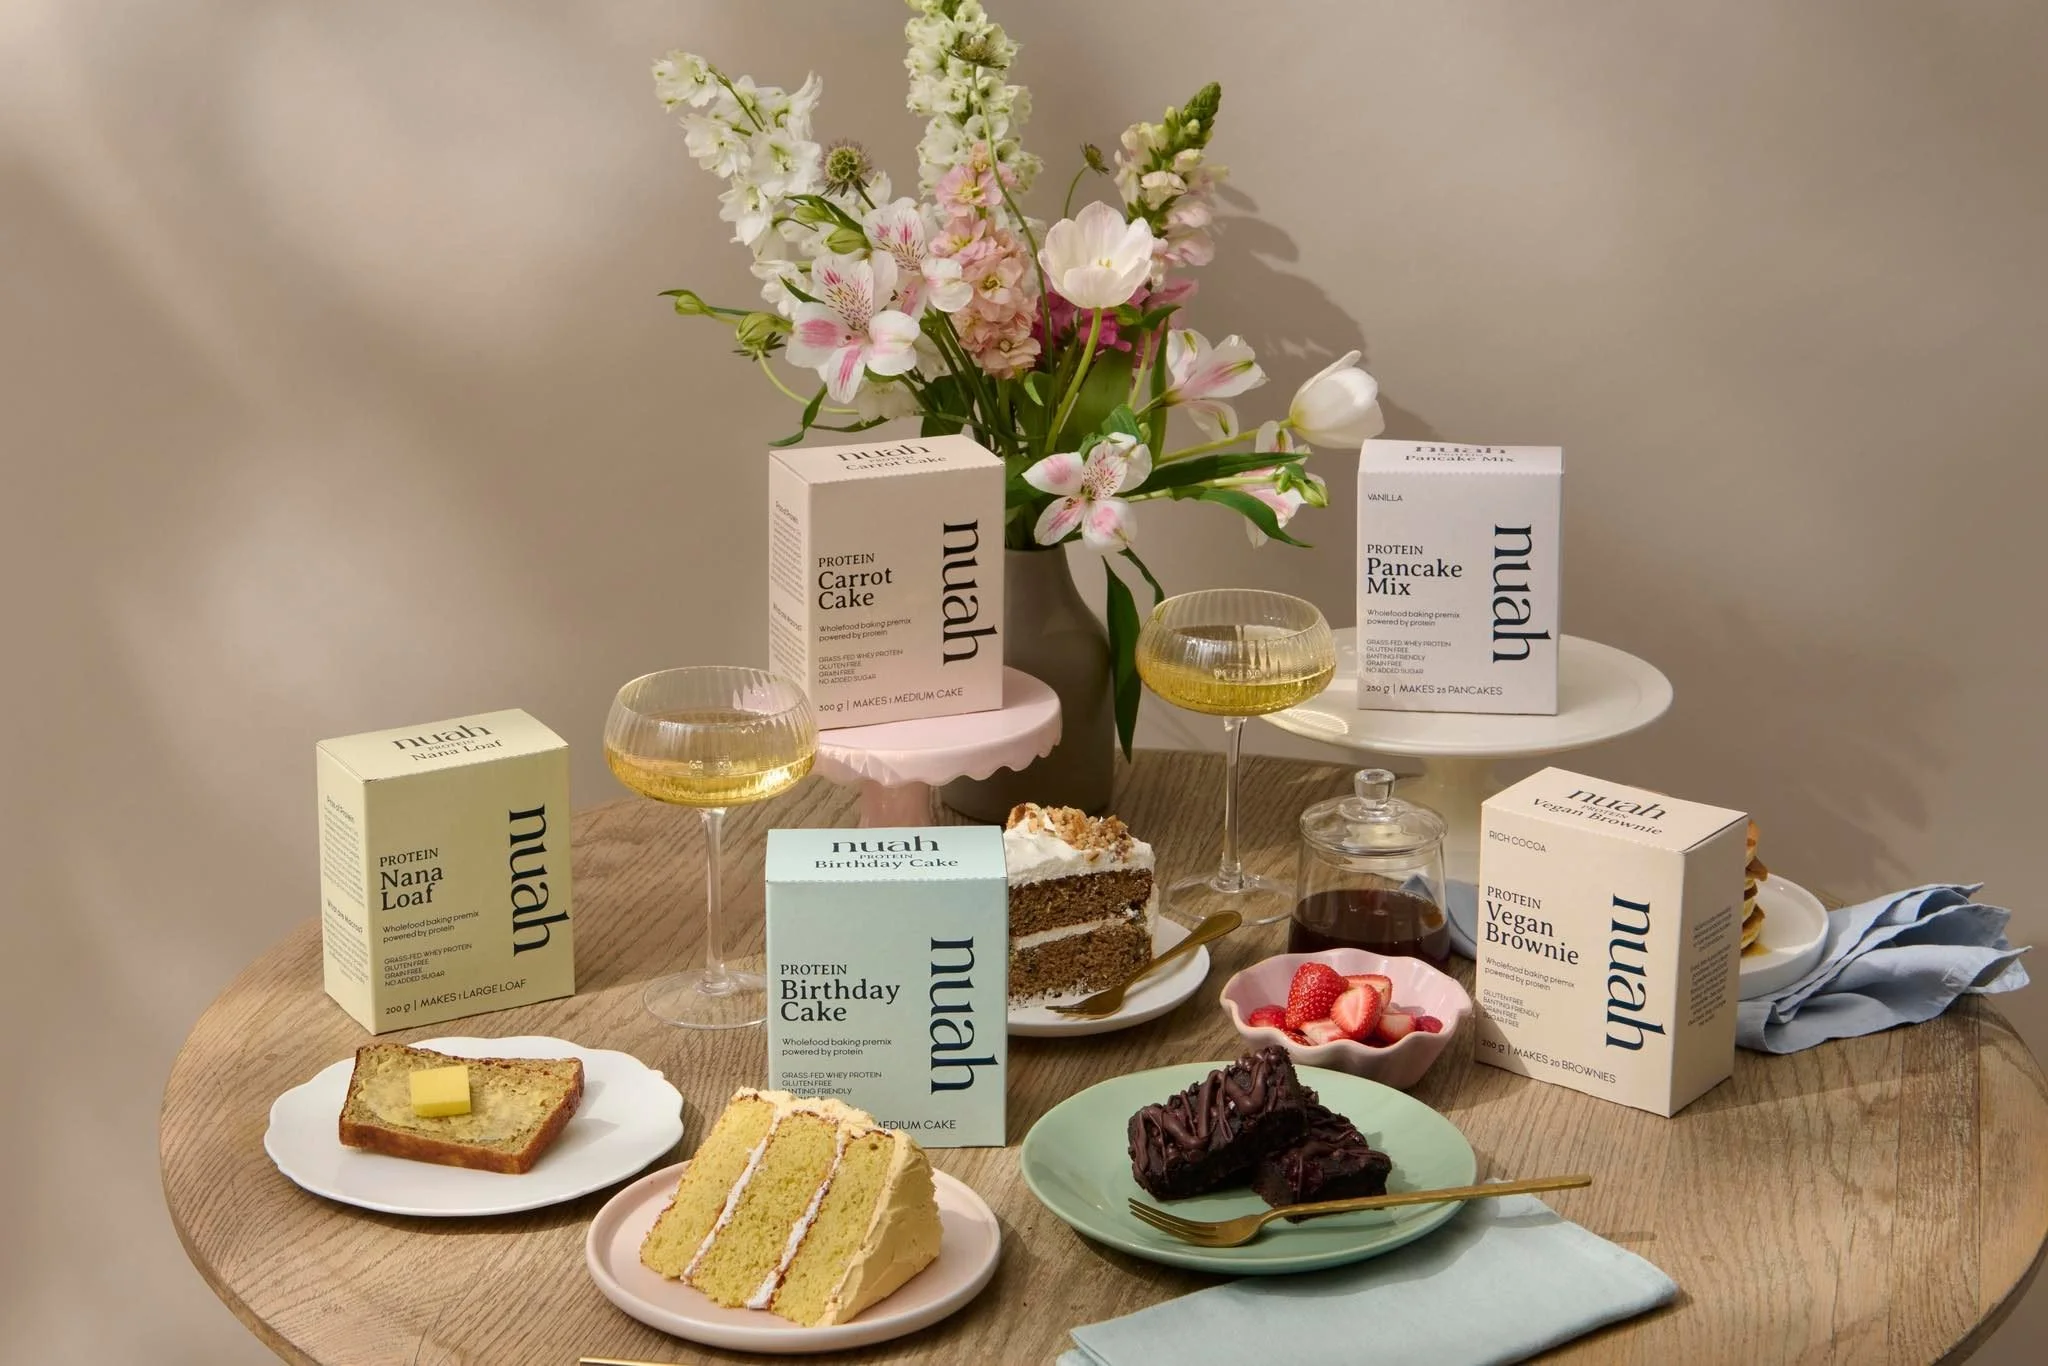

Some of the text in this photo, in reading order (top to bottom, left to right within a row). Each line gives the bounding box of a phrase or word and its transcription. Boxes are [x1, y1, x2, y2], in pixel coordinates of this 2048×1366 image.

[838, 445, 931, 460] nuah
[846, 461, 900, 470] Carrot
[1367, 544, 1423, 555] PROTEIN
[818, 552, 874, 568] PROTEIN
[1368, 558, 1462, 577] Pancake
[818, 568, 892, 590] Carrot
[1368, 577, 1411, 595] Mix
[818, 588, 874, 610] Cake
[942, 519, 998, 666] nuah
[1492, 523, 1551, 663] nuah
[1367, 618, 1398, 626] powered
[1400, 619, 1408, 627] by
[1409, 610, 1433, 618] baking
[819, 618, 911, 632] Wholefood baking premix
[819, 629, 887, 642] powered by protein
[857, 651, 875, 659] WHEY
[853, 696, 887, 708] MAKES
[894, 691, 935, 703] MEDIUM
[937, 687, 964, 698] CAKE
[1400, 685, 1435, 693] MAKES
[1448, 685, 1502, 695] PANCAKES
[392, 725, 493, 750] nuah
[410, 740, 503, 760] Nana Loaf
[1566, 790, 1666, 820] nuah
[1581, 805, 1628, 819] PROTEIN
[1533, 798, 1663, 835] Vegan Brownie
[832, 835, 939, 852] nuah
[1489, 830, 1547, 852] RICH COCOA
[380, 848, 438, 867] PROTEIN
[815, 859, 959, 869] Birthday Cake
[380, 867, 443, 890] Nana
[509, 804, 570, 956] nuah
[381, 883, 435, 911] Loaf
[1488, 886, 1541, 909] PROTEIN
[382, 911, 479, 933] Wholefood baking premix
[1486, 900, 1554, 937] Vegan
[383, 925, 455, 944] powered by protein
[1486, 921, 1578, 965] Brownie
[423, 948, 443, 957] WHEY
[443, 944, 472, 954] PROTEIN
[384, 961, 413, 972] GLUTEN
[385, 971, 407, 979] GRAIN
[781, 964, 848, 976] PROTEIN
[1486, 957, 1575, 988] Wholefood baking premix
[1606, 892, 1667, 1052] nuah
[397, 975, 420, 984] ADDED
[421, 970, 445, 981] SUGAR
[1484, 967, 1550, 990] powered by protein
[420, 993, 457, 1008] MAKES
[463, 984, 498, 1000] LARGE
[500, 978, 526, 992] LOAF
[781, 978, 900, 1005] Birthday
[1483, 989, 1510, 1001] GLUTEN
[781, 1001, 847, 1022] Cake
[929, 936, 999, 1095] nuah
[1504, 1011, 1518, 1020] FREE
[1505, 1018, 1519, 1028] FREE
[782, 1038, 892, 1047] Wholefood baking premix
[782, 1048, 863, 1057] powered by protein
[1481, 1040, 1496, 1049] 200
[1514, 1048, 1549, 1064] MAKES
[1550, 1059, 1560, 1067] 20
[1562, 1060, 1616, 1084] BROWNIES
[924, 1120, 956, 1129] CAKE
